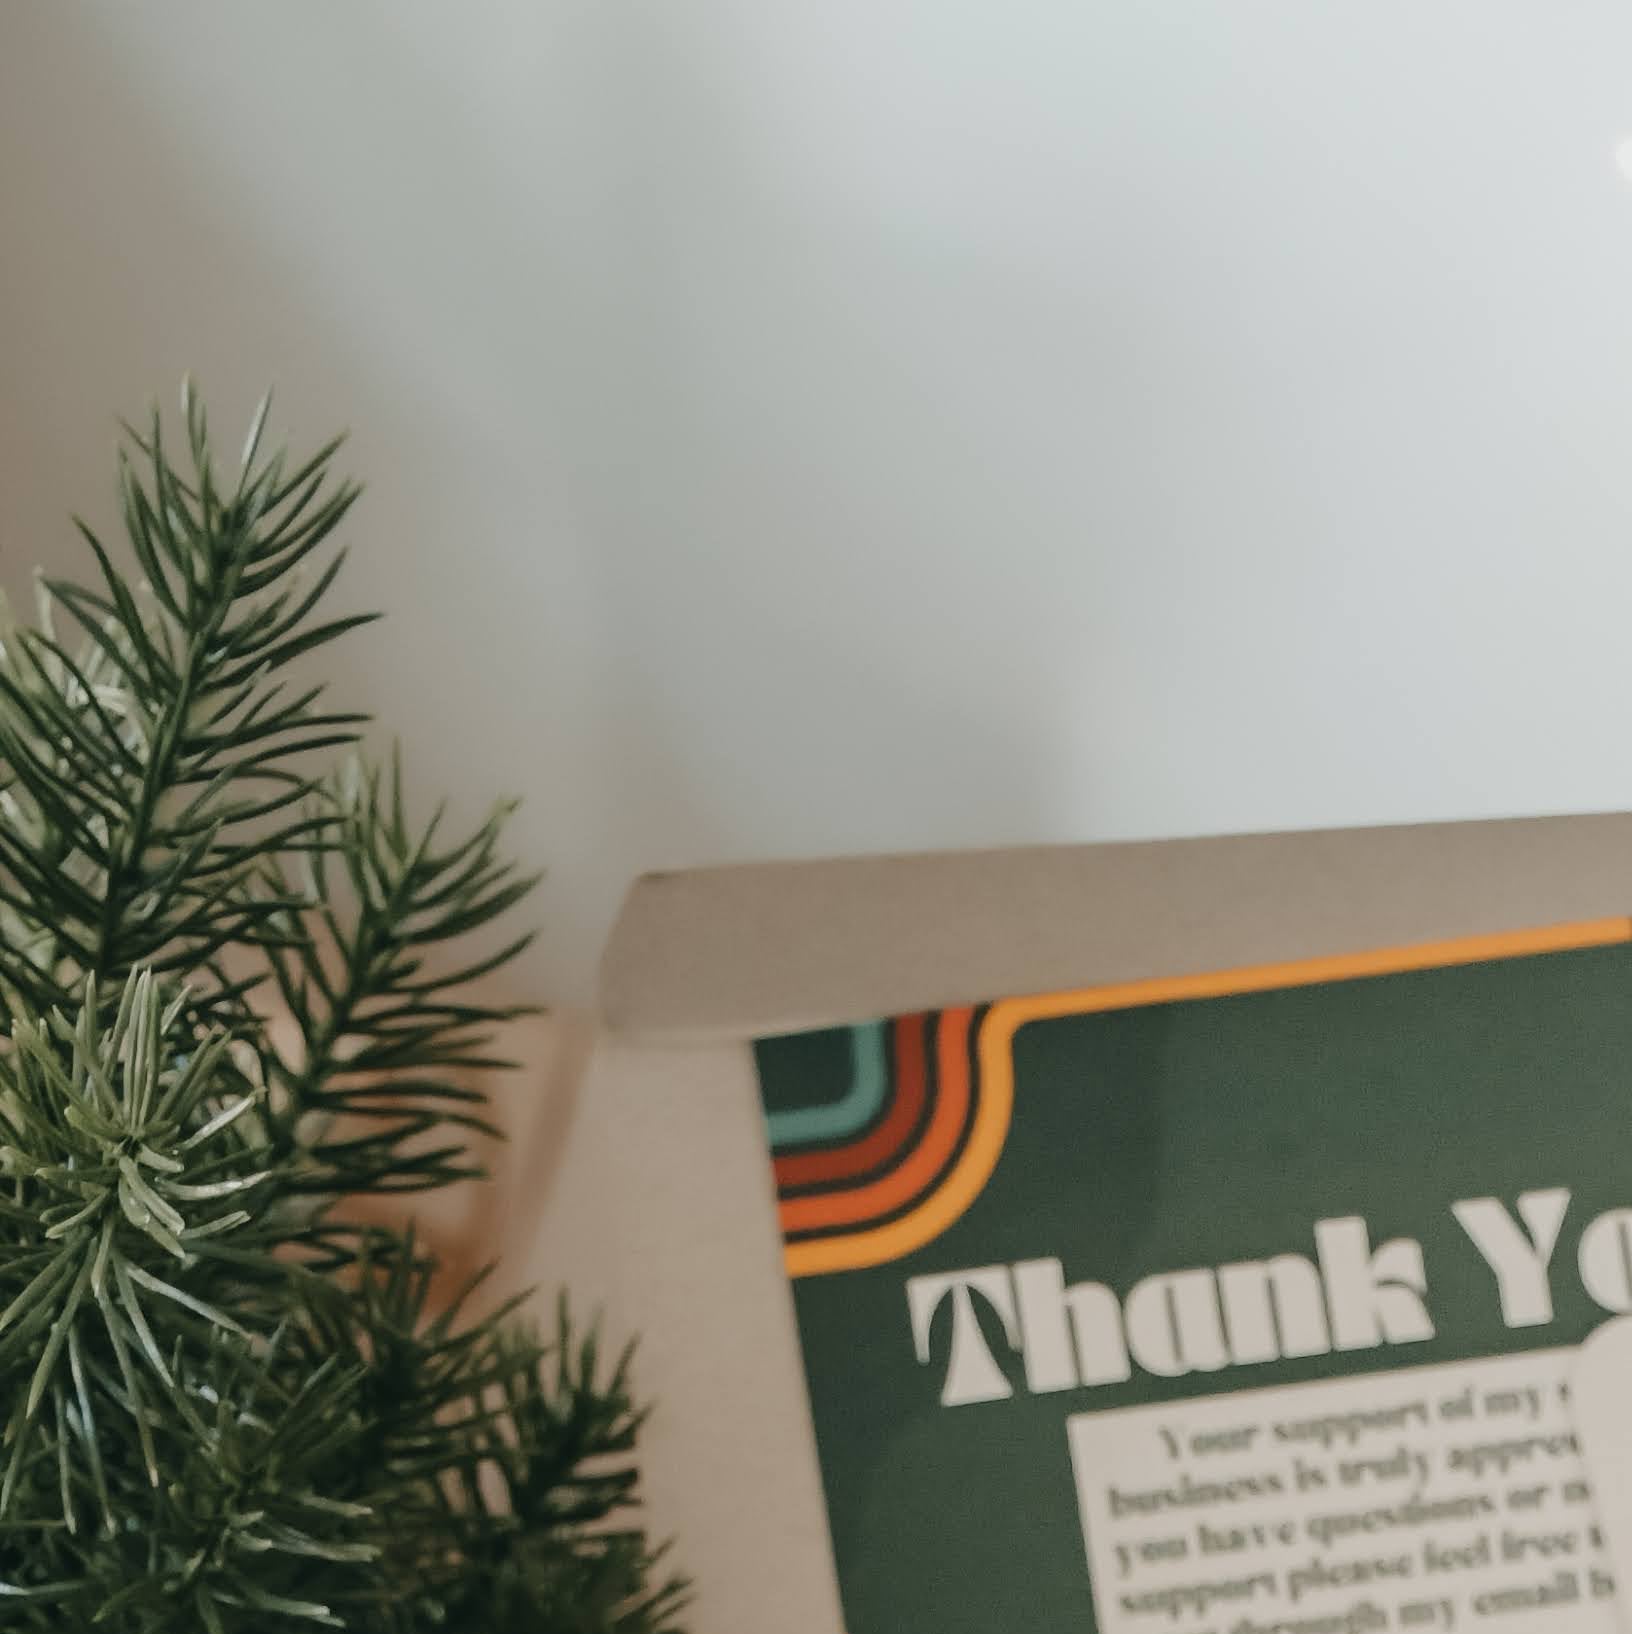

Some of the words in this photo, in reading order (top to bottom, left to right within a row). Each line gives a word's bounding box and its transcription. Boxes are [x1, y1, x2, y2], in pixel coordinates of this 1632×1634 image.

[905, 1214, 1437, 1408] Thank
[1158, 1422, 1261, 1461] Your
[1273, 1399, 1430, 1450] support
[1437, 1383, 1477, 1421] of
[1484, 1384, 1544, 1420] my
[1107, 1469, 1283, 1520] business
[1294, 1455, 1329, 1494] is
[1339, 1443, 1432, 1491] truly
[1114, 1534, 1188, 1579] you
[1198, 1515, 1297, 1558] have
[1304, 1491, 1496, 1544] questions
[1505, 1480, 1551, 1513] or
[1120, 1570, 1276, 1620] support
[1287, 1550, 1411, 1603] please
[1422, 1533, 1491, 1573] feel
[1500, 1524, 1579, 1563] free
[1398, 1597, 1457, 1633] my
[1472, 1569, 1581, 1618] email
